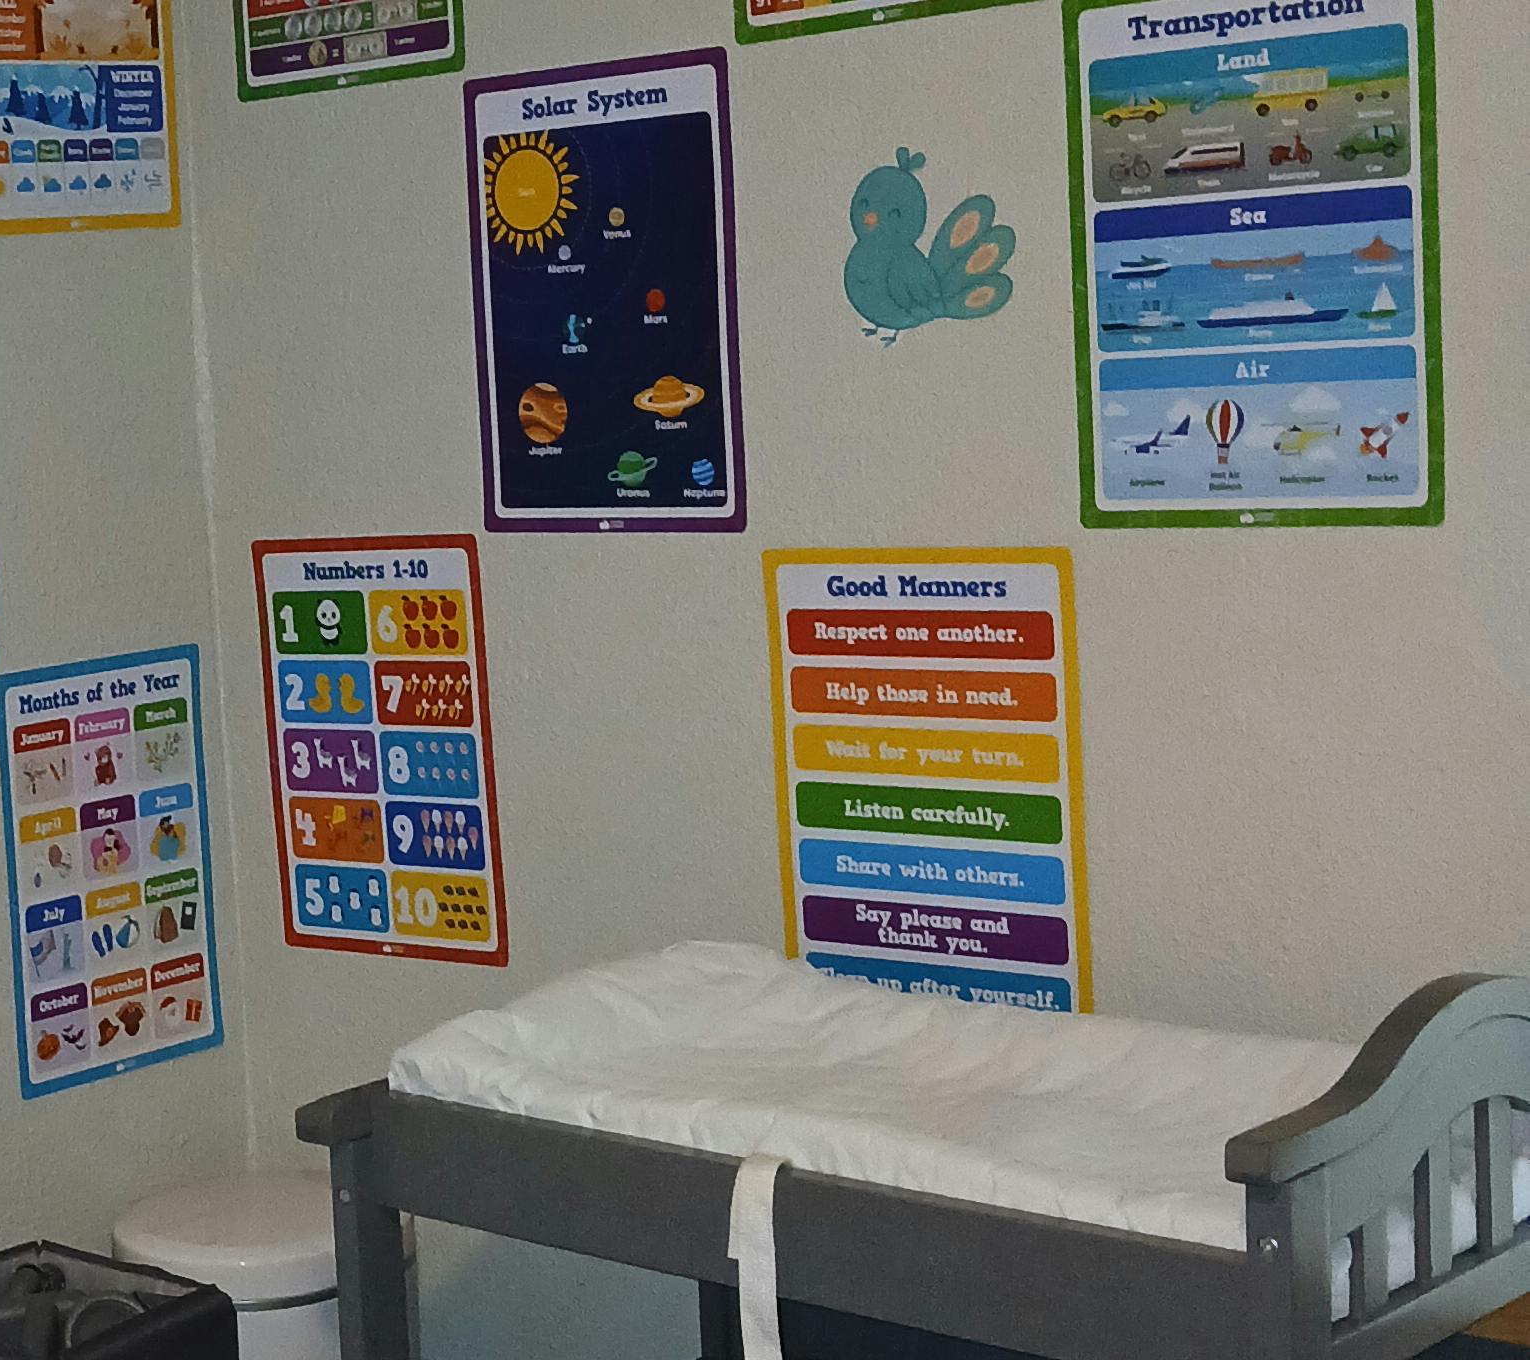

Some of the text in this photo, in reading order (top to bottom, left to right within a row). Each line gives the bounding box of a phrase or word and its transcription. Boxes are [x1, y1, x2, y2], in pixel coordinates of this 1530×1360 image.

[1217, 47, 1271, 72] Land
[110, 70, 154, 84] WINTER
[522, 87, 668, 121] Solar System
[1229, 207, 1267, 227] Sea
[547, 262, 586, 275] Mercury
[643, 314, 669, 325] Mars
[561, 344, 588, 354] Earth
[1235, 359, 1271, 380] Air
[654, 420, 688, 431] Saturn
[683, 488, 726, 500] Neptune
[302, 559, 430, 581] Numbers 1-10
[826, 574, 1008, 598] Good Manners
[279, 604, 398, 644] 1 6
[813, 621, 1025, 645] Respect one another.
[18, 672, 181, 714] Months of the Year
[284, 673, 404, 714] 2 7
[826, 682, 1019, 707] Help those in need.
[78, 717, 126, 735] February
[291, 741, 411, 784] 3 8
[825, 740, 1025, 768] Wait for your turn.
[96, 806, 120, 823] May
[844, 799, 1011, 832] Listen carefully.
[295, 808, 414, 854] 4 9
[836, 854, 1025, 888] Share with others.
[42, 906, 66, 923] July
[305, 878, 437, 927] 5 10
[855, 903, 1011, 936] Say please and
[877, 926, 989, 955] thank you.
[39, 992, 80, 1013] October
[154, 961, 202, 983] December
[908, 977, 961, 999] after
